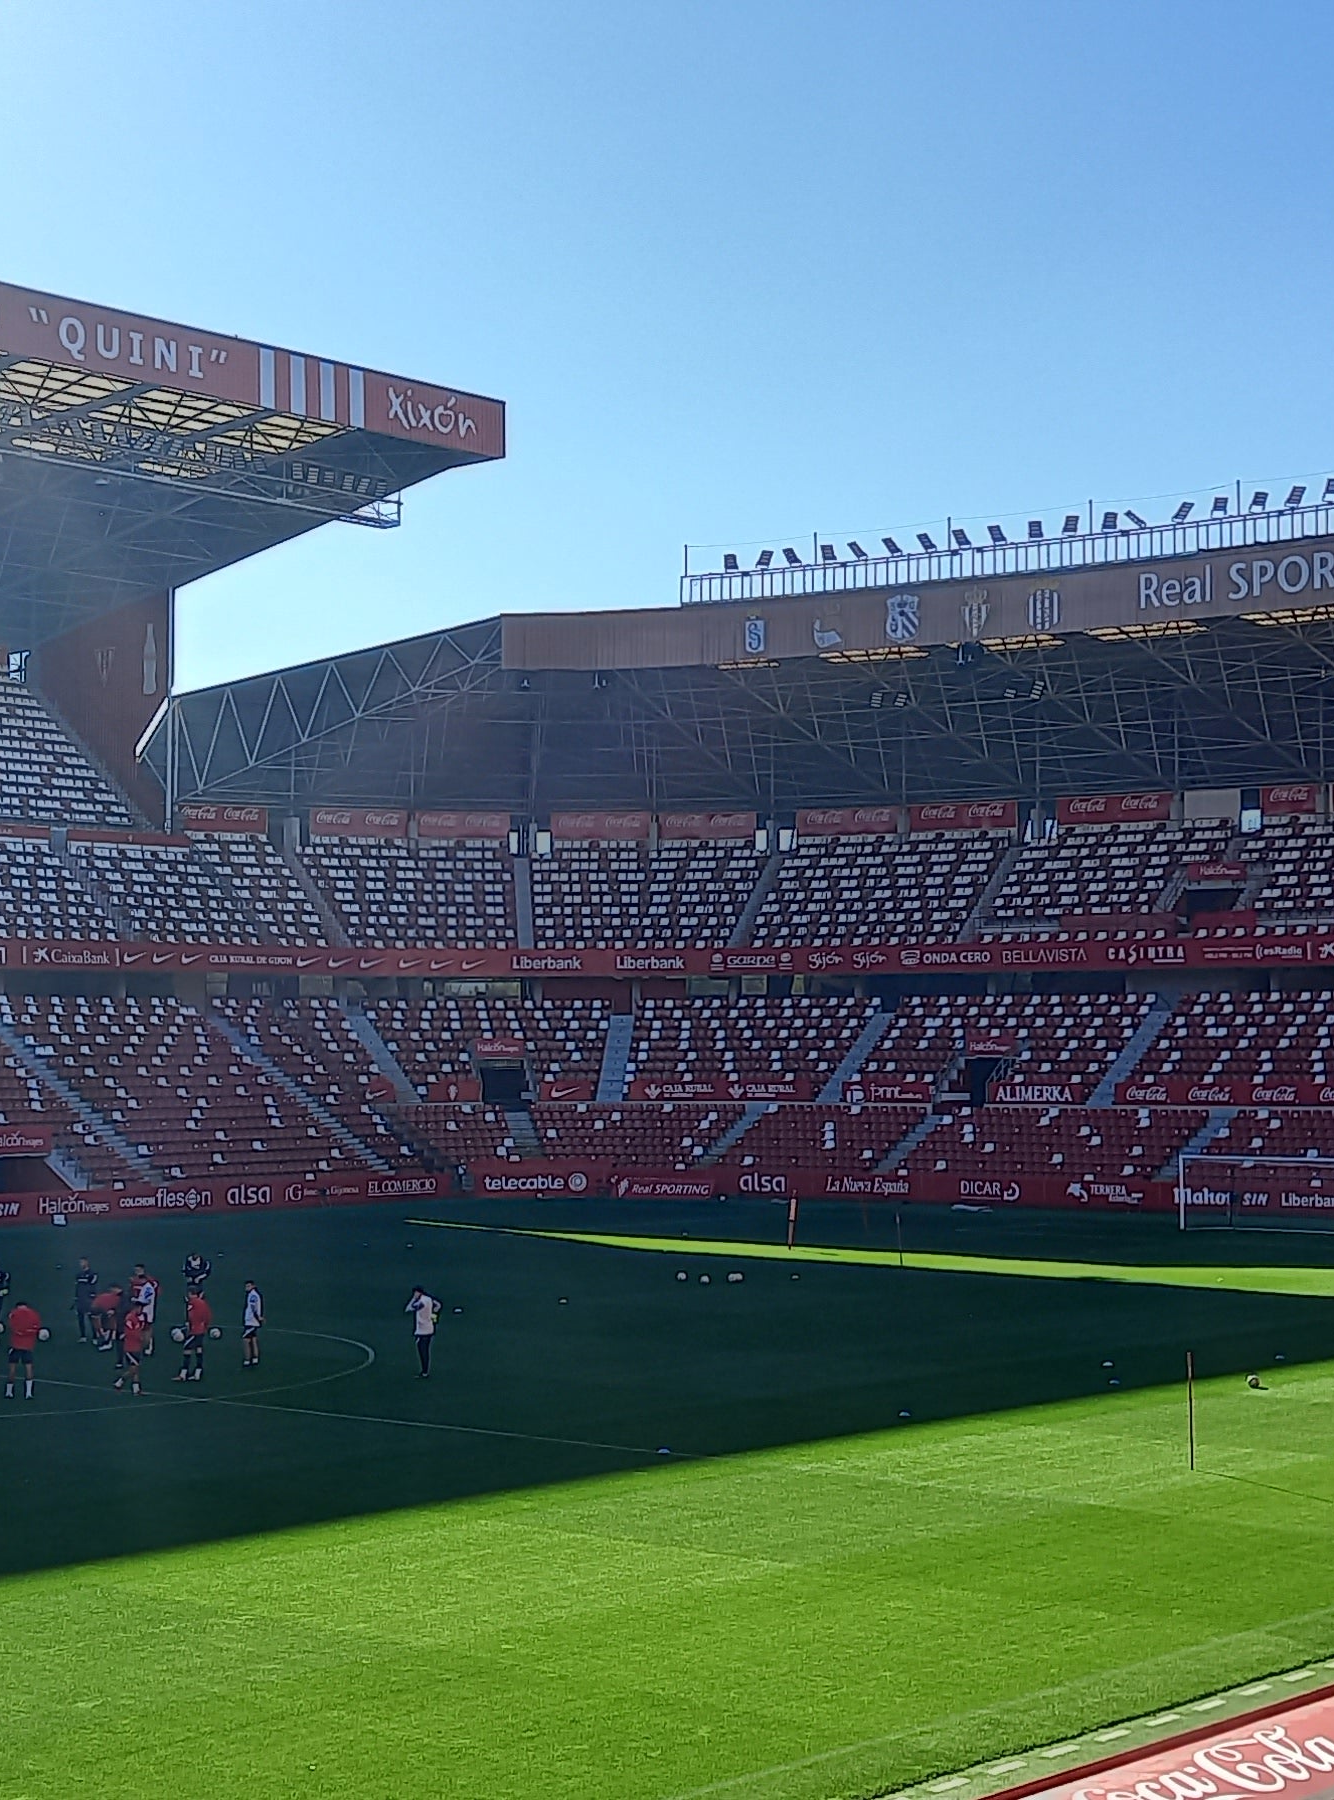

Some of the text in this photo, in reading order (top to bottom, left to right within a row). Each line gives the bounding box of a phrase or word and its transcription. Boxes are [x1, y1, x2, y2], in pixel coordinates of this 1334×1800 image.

[387, 386, 478, 437] Xixón
[1138, 564, 1213, 609] Real
[1269, 786, 1309, 801] Coca-Cola
[1068, 797, 1105, 813] Coca-Cola
[1121, 794, 1160, 810] Coca-Cola
[807, 811, 843, 825] Coca-Cola
[854, 808, 889, 823] Coca-Cola
[920, 804, 957, 820] Coca-Cola
[968, 802, 1005, 819] Coca-Cola
[50, 949, 110, 965] CaixaBank
[511, 954, 582, 970] Liberbank
[616, 953, 685, 970] Liberbank
[808, 951, 843, 970] gijón
[852, 950, 888, 970] gijón
[922, 951, 991, 964] ONDA CERO
[1002, 948, 1087, 964] BELLAVISTA
[995, 1085, 1073, 1101] ALIMERKA
[1125, 1085, 1169, 1103] Coca-Cola
[1188, 1085, 1232, 1102] Coca-Cola
[1251, 1086, 1295, 1103] Coca-Cola
[367, 1178, 436, 1193] EL COMERCIO
[483, 1175, 565, 1192] telecable
[631, 1183, 710, 1195] Real SPORTING
[739, 1174, 786, 1192] alsa
[825, 1176, 909, 1197] La Nueva España
[960, 1181, 1002, 1195] DICAR
[1090, 1183, 1127, 1195] TERNERA
[227, 1184, 273, 1205] alsa
[1173, 1187, 1269, 1207] Maho SIN
[39, 1194, 86, 1216] Halcón
